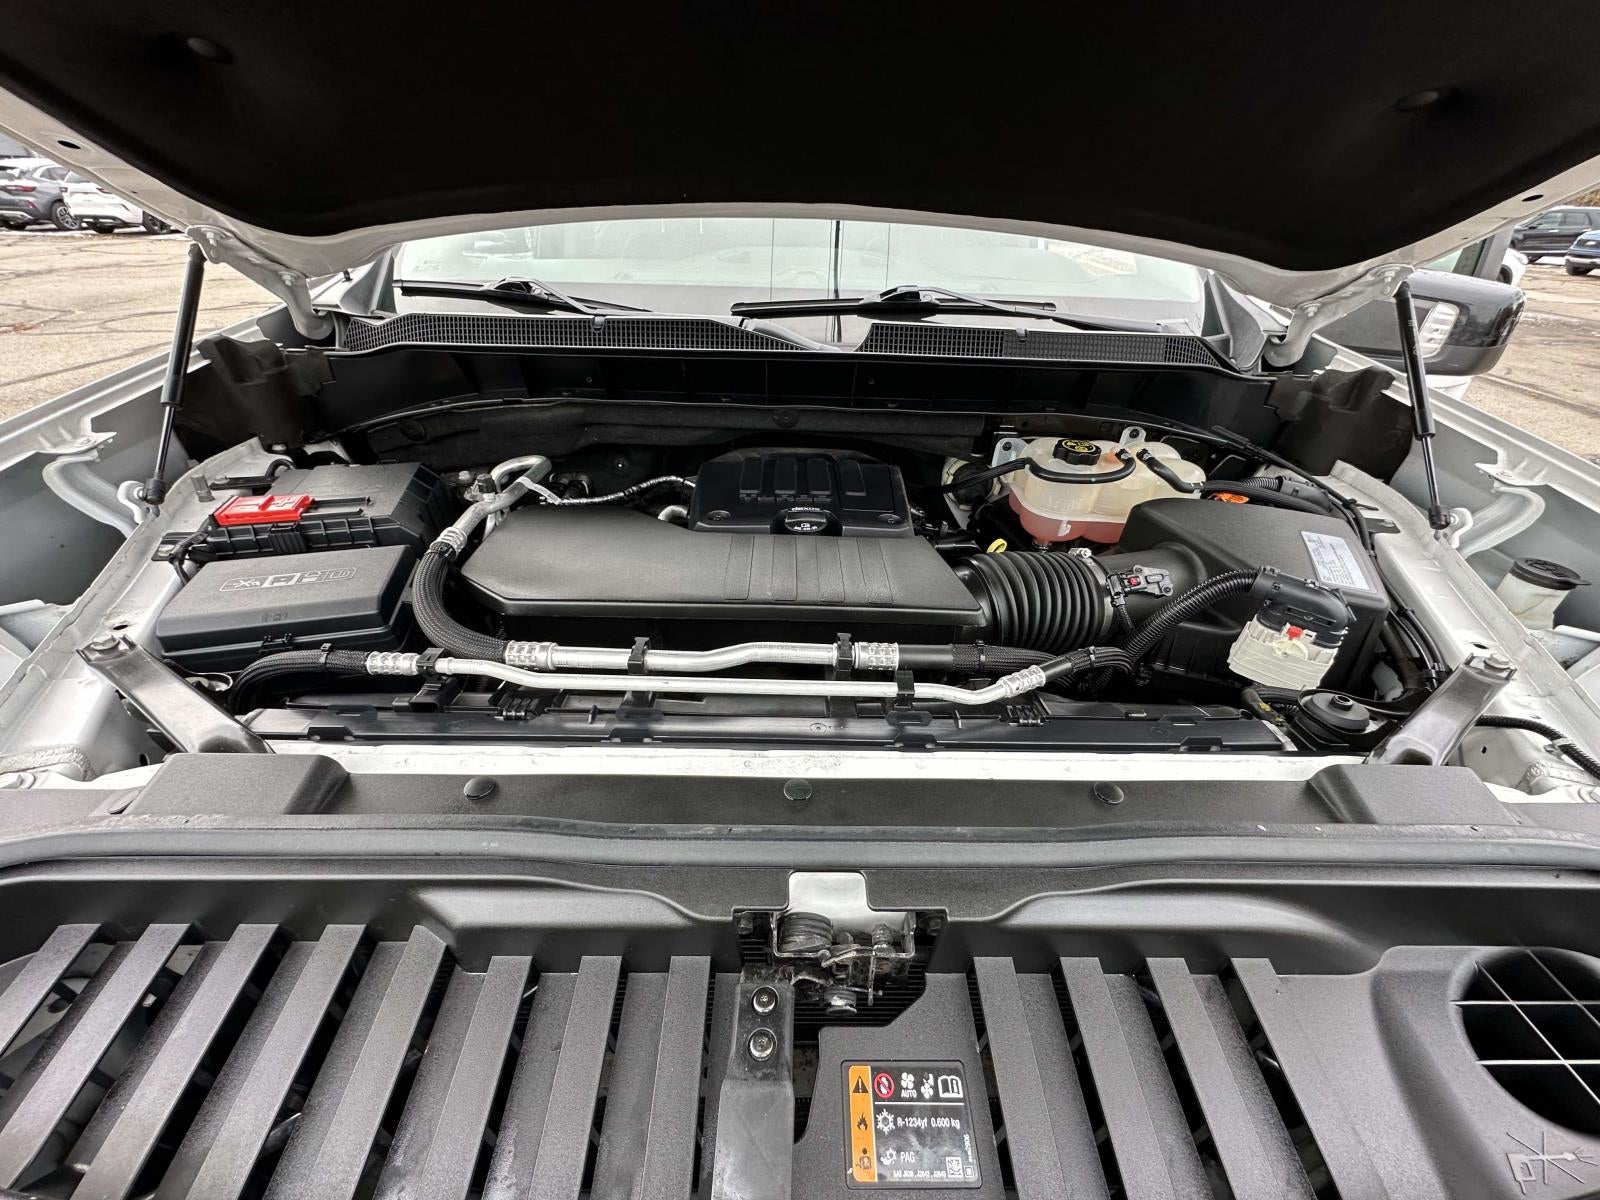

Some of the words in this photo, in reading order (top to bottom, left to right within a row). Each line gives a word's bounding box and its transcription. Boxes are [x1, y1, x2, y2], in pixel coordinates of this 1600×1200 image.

[900, 1090, 917, 1098] AUTO
[896, 1117, 928, 1129] R-1234yf
[930, 1117, 950, 1127] 0.600
[951, 1117, 961, 1129] kg
[900, 1151, 915, 1163] PAG
